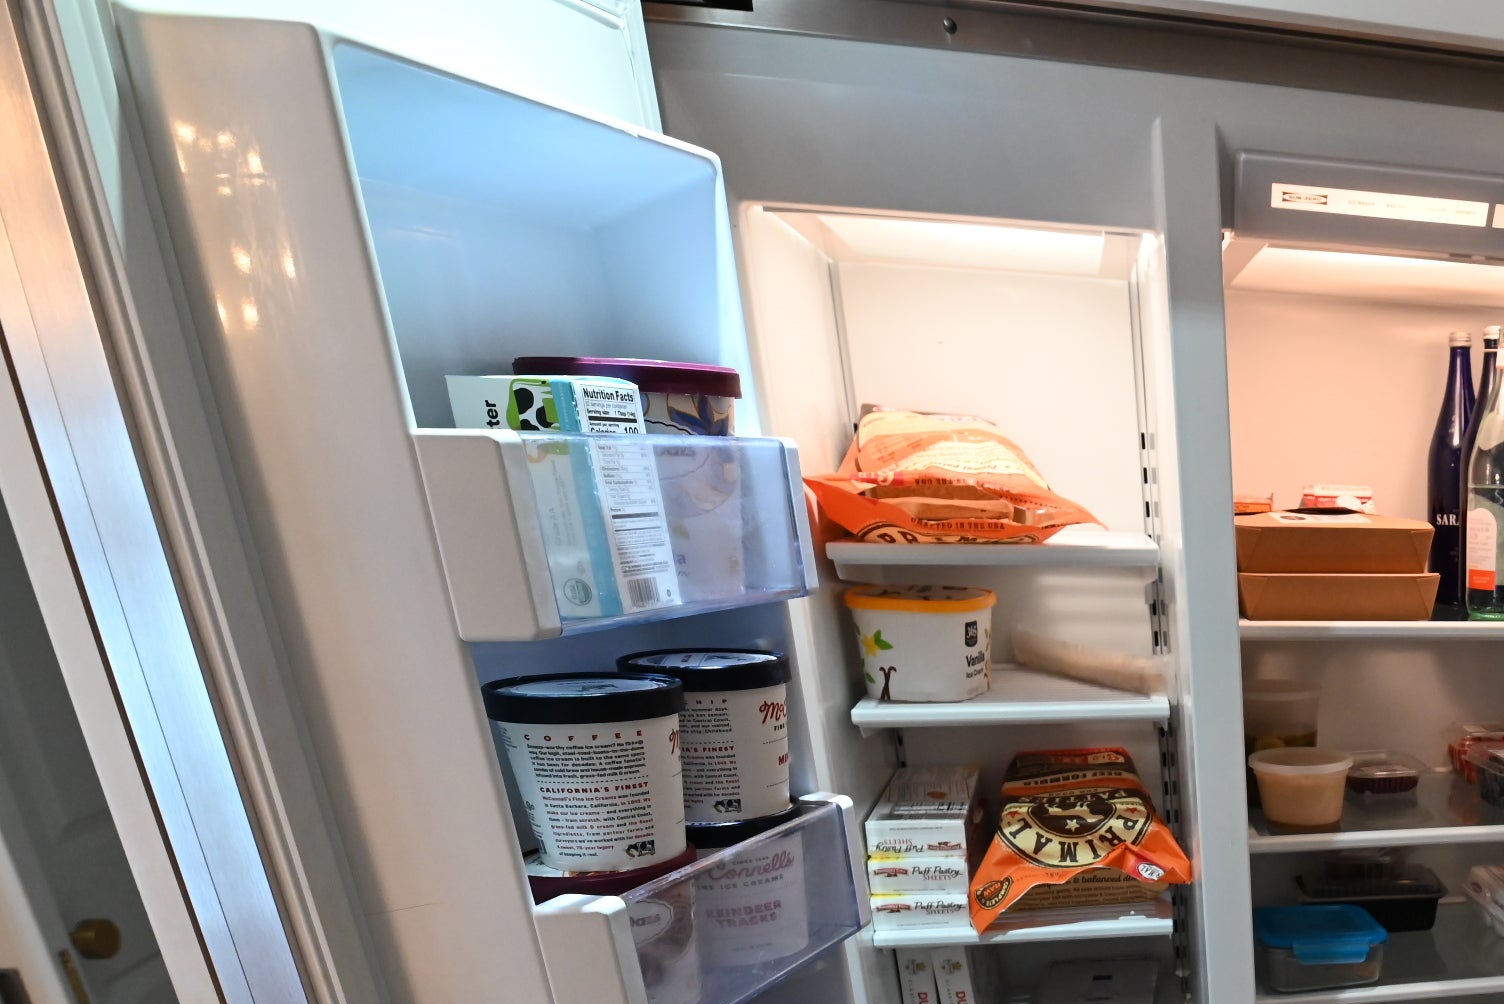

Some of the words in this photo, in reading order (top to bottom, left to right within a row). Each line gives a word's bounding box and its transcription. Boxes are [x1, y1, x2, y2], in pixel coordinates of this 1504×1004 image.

[583, 387, 615, 401] Nutrition
[615, 390, 634, 403] Facts
[967, 522, 985, 530] THE
[987, 521, 1005, 530] USA
[966, 650, 986, 668] Vanilla
[539, 786, 611, 794] CALIFORNIA'S
[614, 781, 649, 792] FINEST
[1008, 814, 1139, 863] PRIMAL
[911, 866, 932, 876] Puff
[932, 866, 964, 878] Pastry
[705, 899, 782, 918] REINDEER
[914, 902, 933, 911] Puff
[935, 901, 966, 913] Pastry
[715, 911, 777, 928] TRACKS
